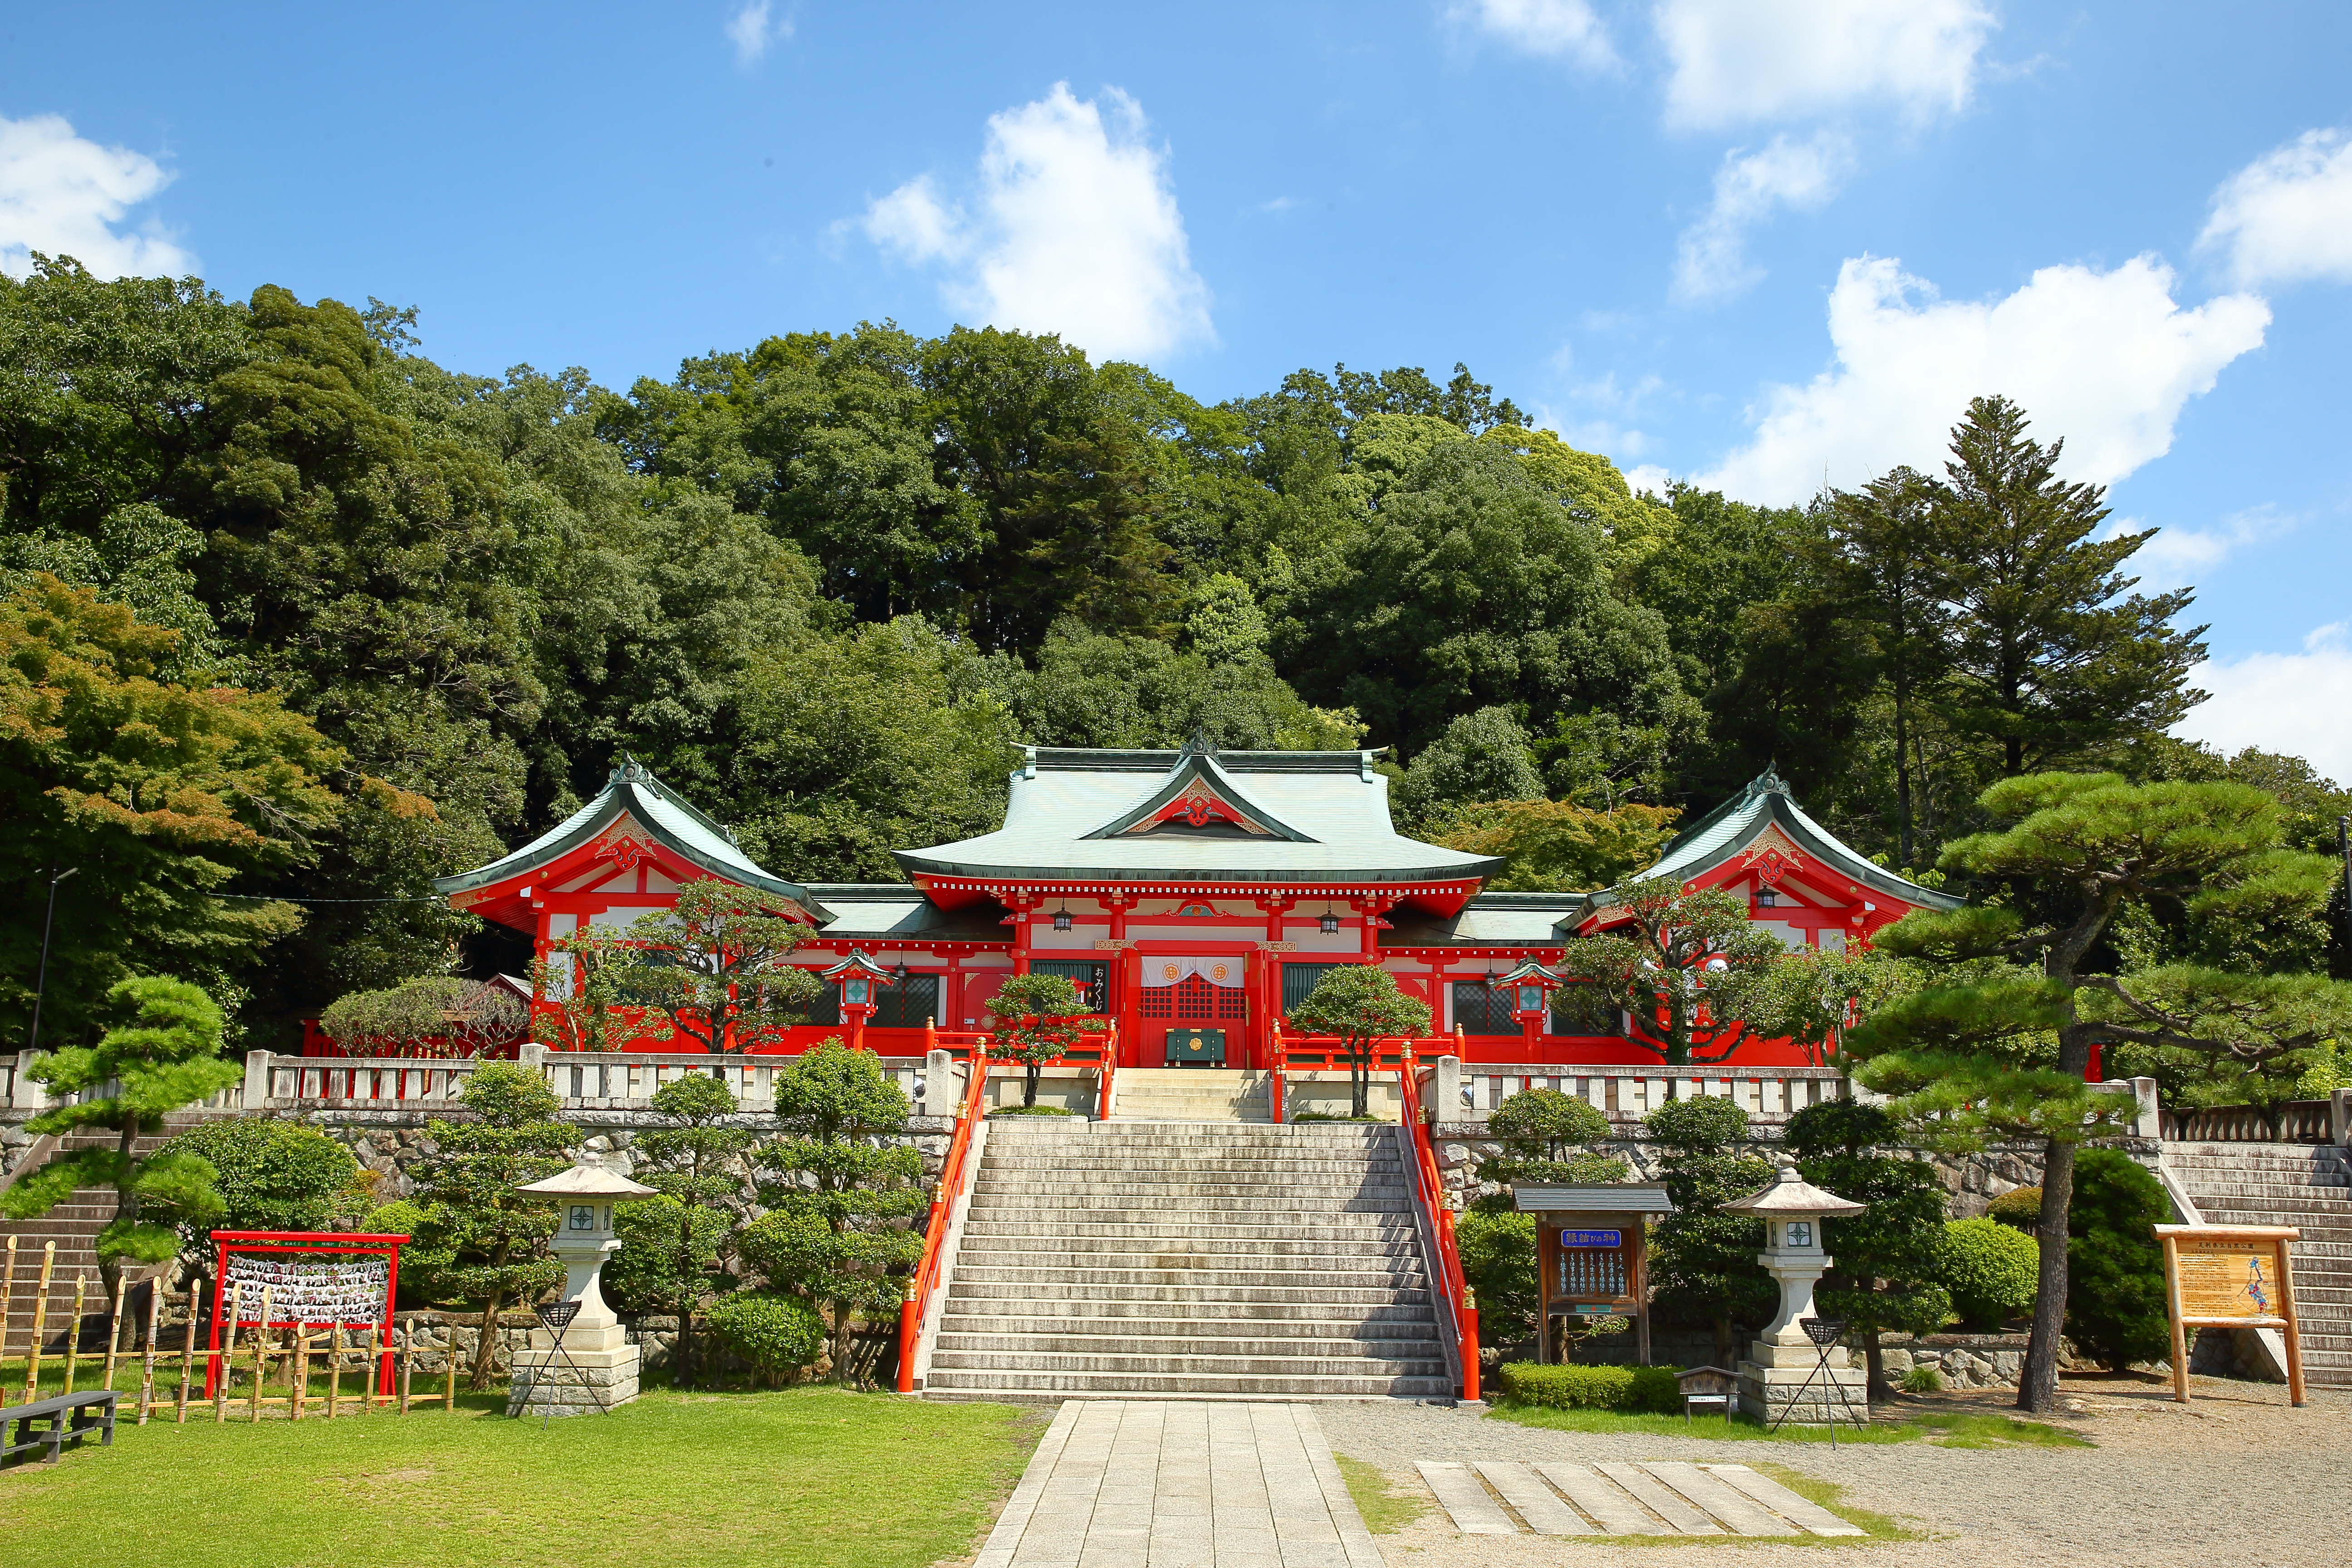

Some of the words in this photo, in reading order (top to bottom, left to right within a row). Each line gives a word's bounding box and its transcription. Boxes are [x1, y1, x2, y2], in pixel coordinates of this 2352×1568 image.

[1095, 967, 1103, 1011] おみくじ
[1566, 1233, 1615, 1243] 縁結びの神
